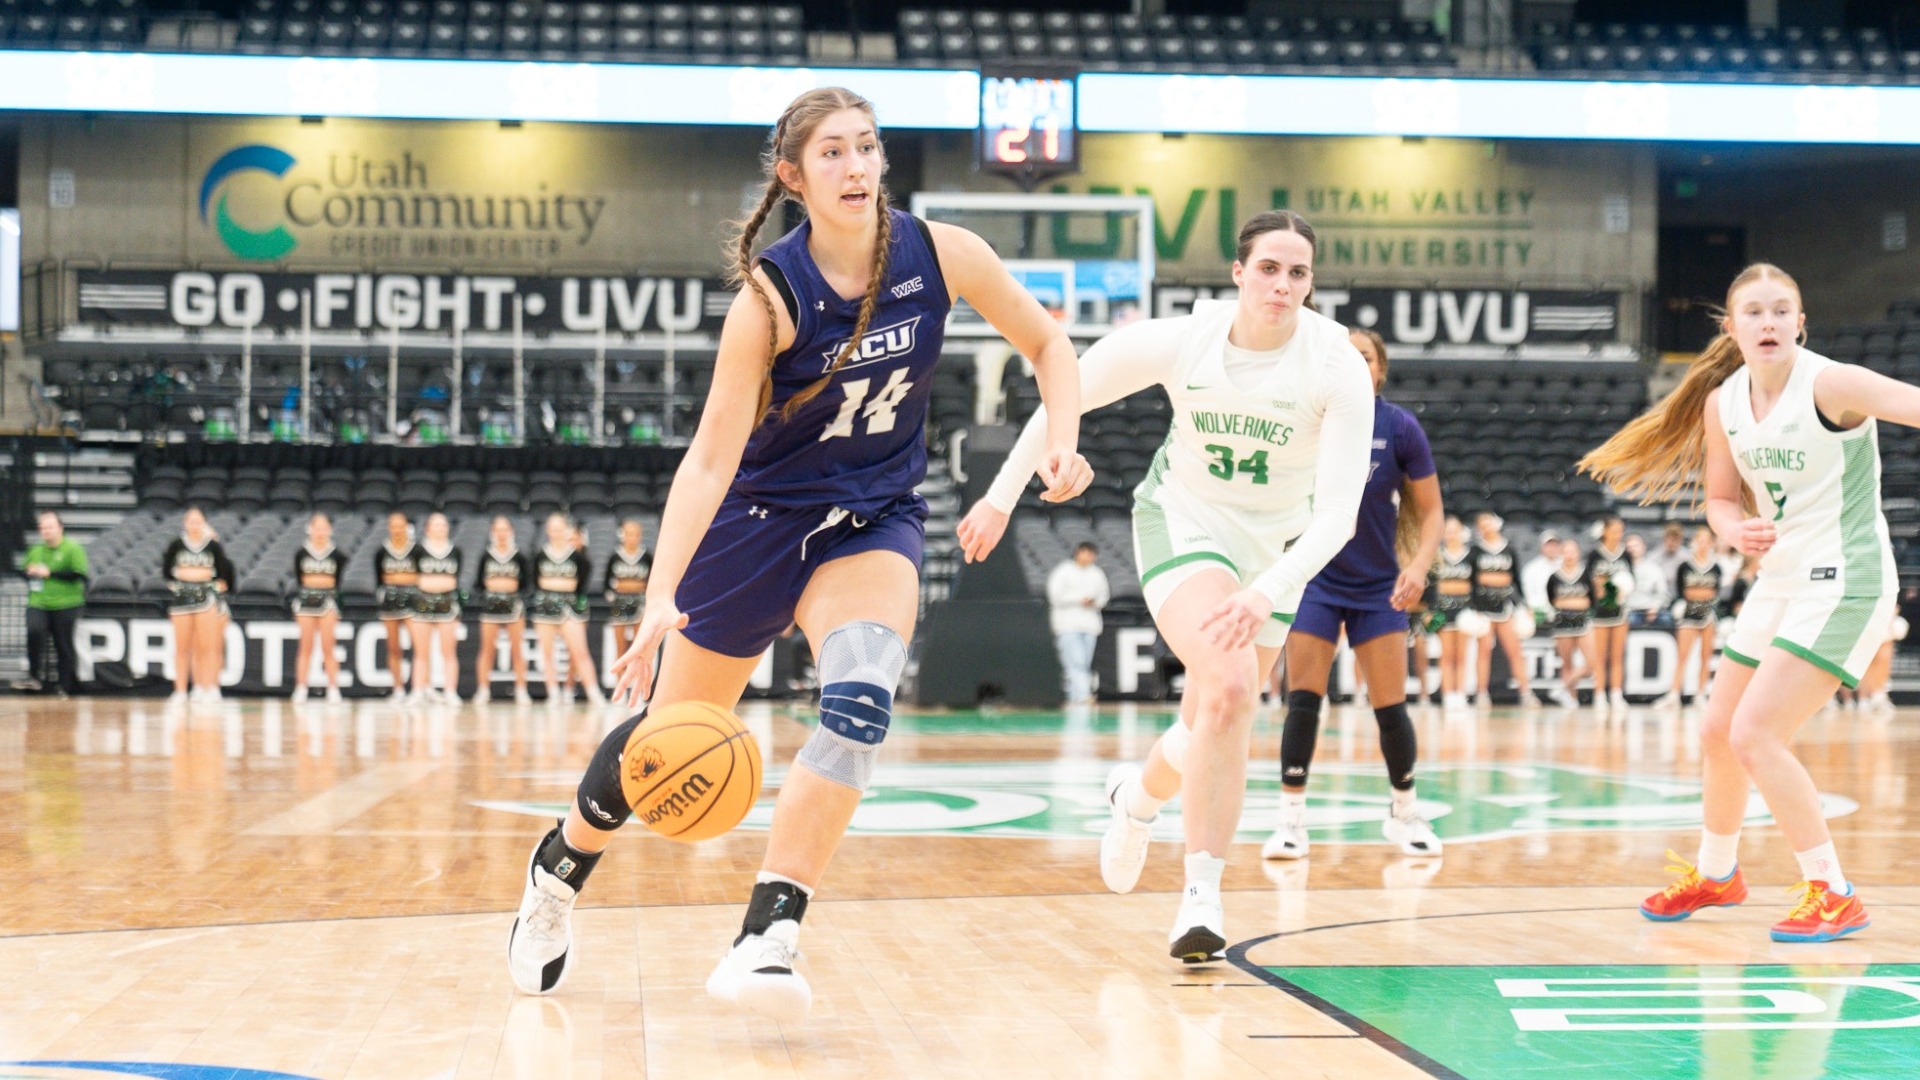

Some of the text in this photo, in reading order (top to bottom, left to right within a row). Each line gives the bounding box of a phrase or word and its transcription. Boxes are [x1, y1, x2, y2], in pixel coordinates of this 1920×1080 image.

[993, 113, 1060, 163] 21
[329, 151, 428, 189] Utah
[283, 180, 606, 247] Community
[1306, 188, 1534, 214] UTAH VALLEY
[330, 233, 561, 256] CREDIT UNION CENTER
[1312, 238, 1534, 266] UNIVERSITY
[171, 272, 703, 332] GO FIGHT UVU
[891, 275, 924, 299] WAC
[1393, 290, 1530, 344] UVU
[831, 324, 912, 366] ACU
[818, 366, 914, 442] 14
[1190, 410, 1294, 447] WOLVERINES
[1204, 443, 1269, 485] 34
[1739, 447, 1806, 472] LVERINES
[641, 772, 715, 826] Wilson
